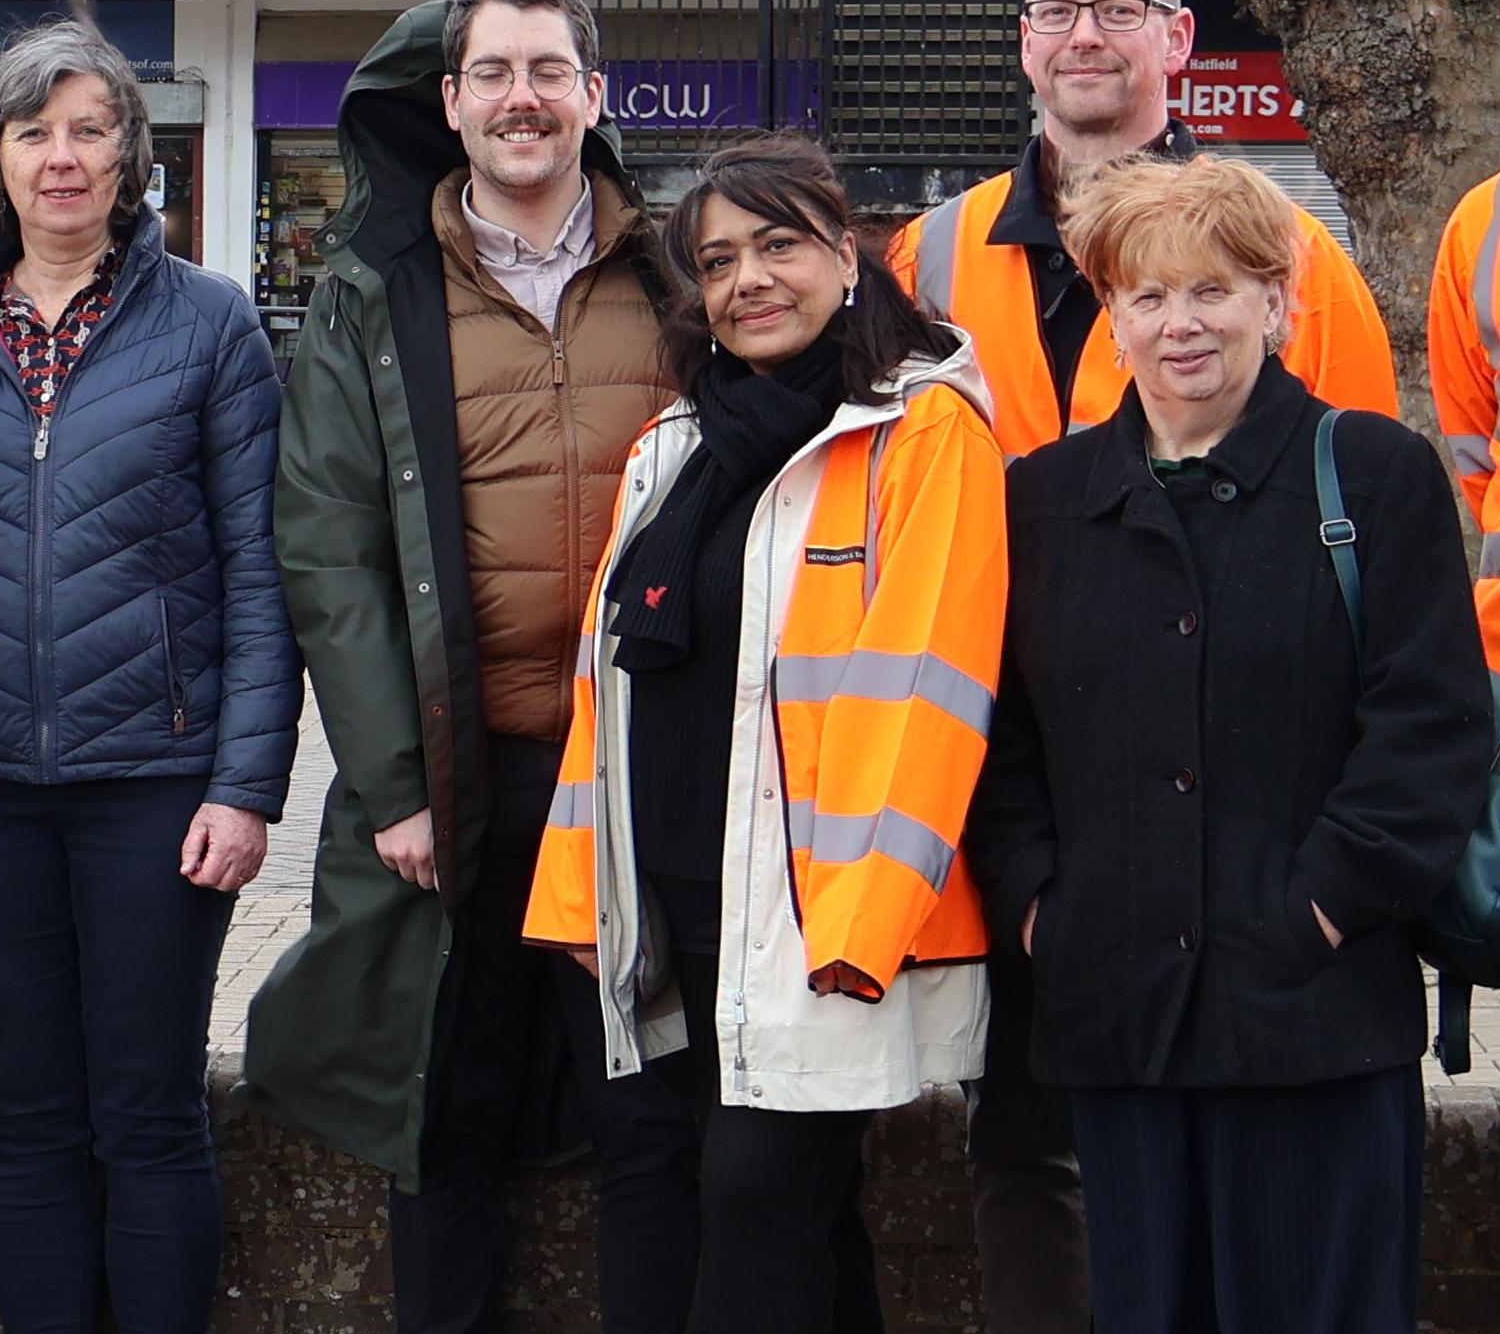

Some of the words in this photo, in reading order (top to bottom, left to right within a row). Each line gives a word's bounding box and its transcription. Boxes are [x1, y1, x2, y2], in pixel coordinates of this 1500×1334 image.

[127, 58, 174, 69] tsof.com
[1190, 58, 1238, 70] Hatfield
[602, 74, 710, 119] llow
[1166, 77, 1280, 117] HERTS
[808, 553, 848, 562] HENDERSON
